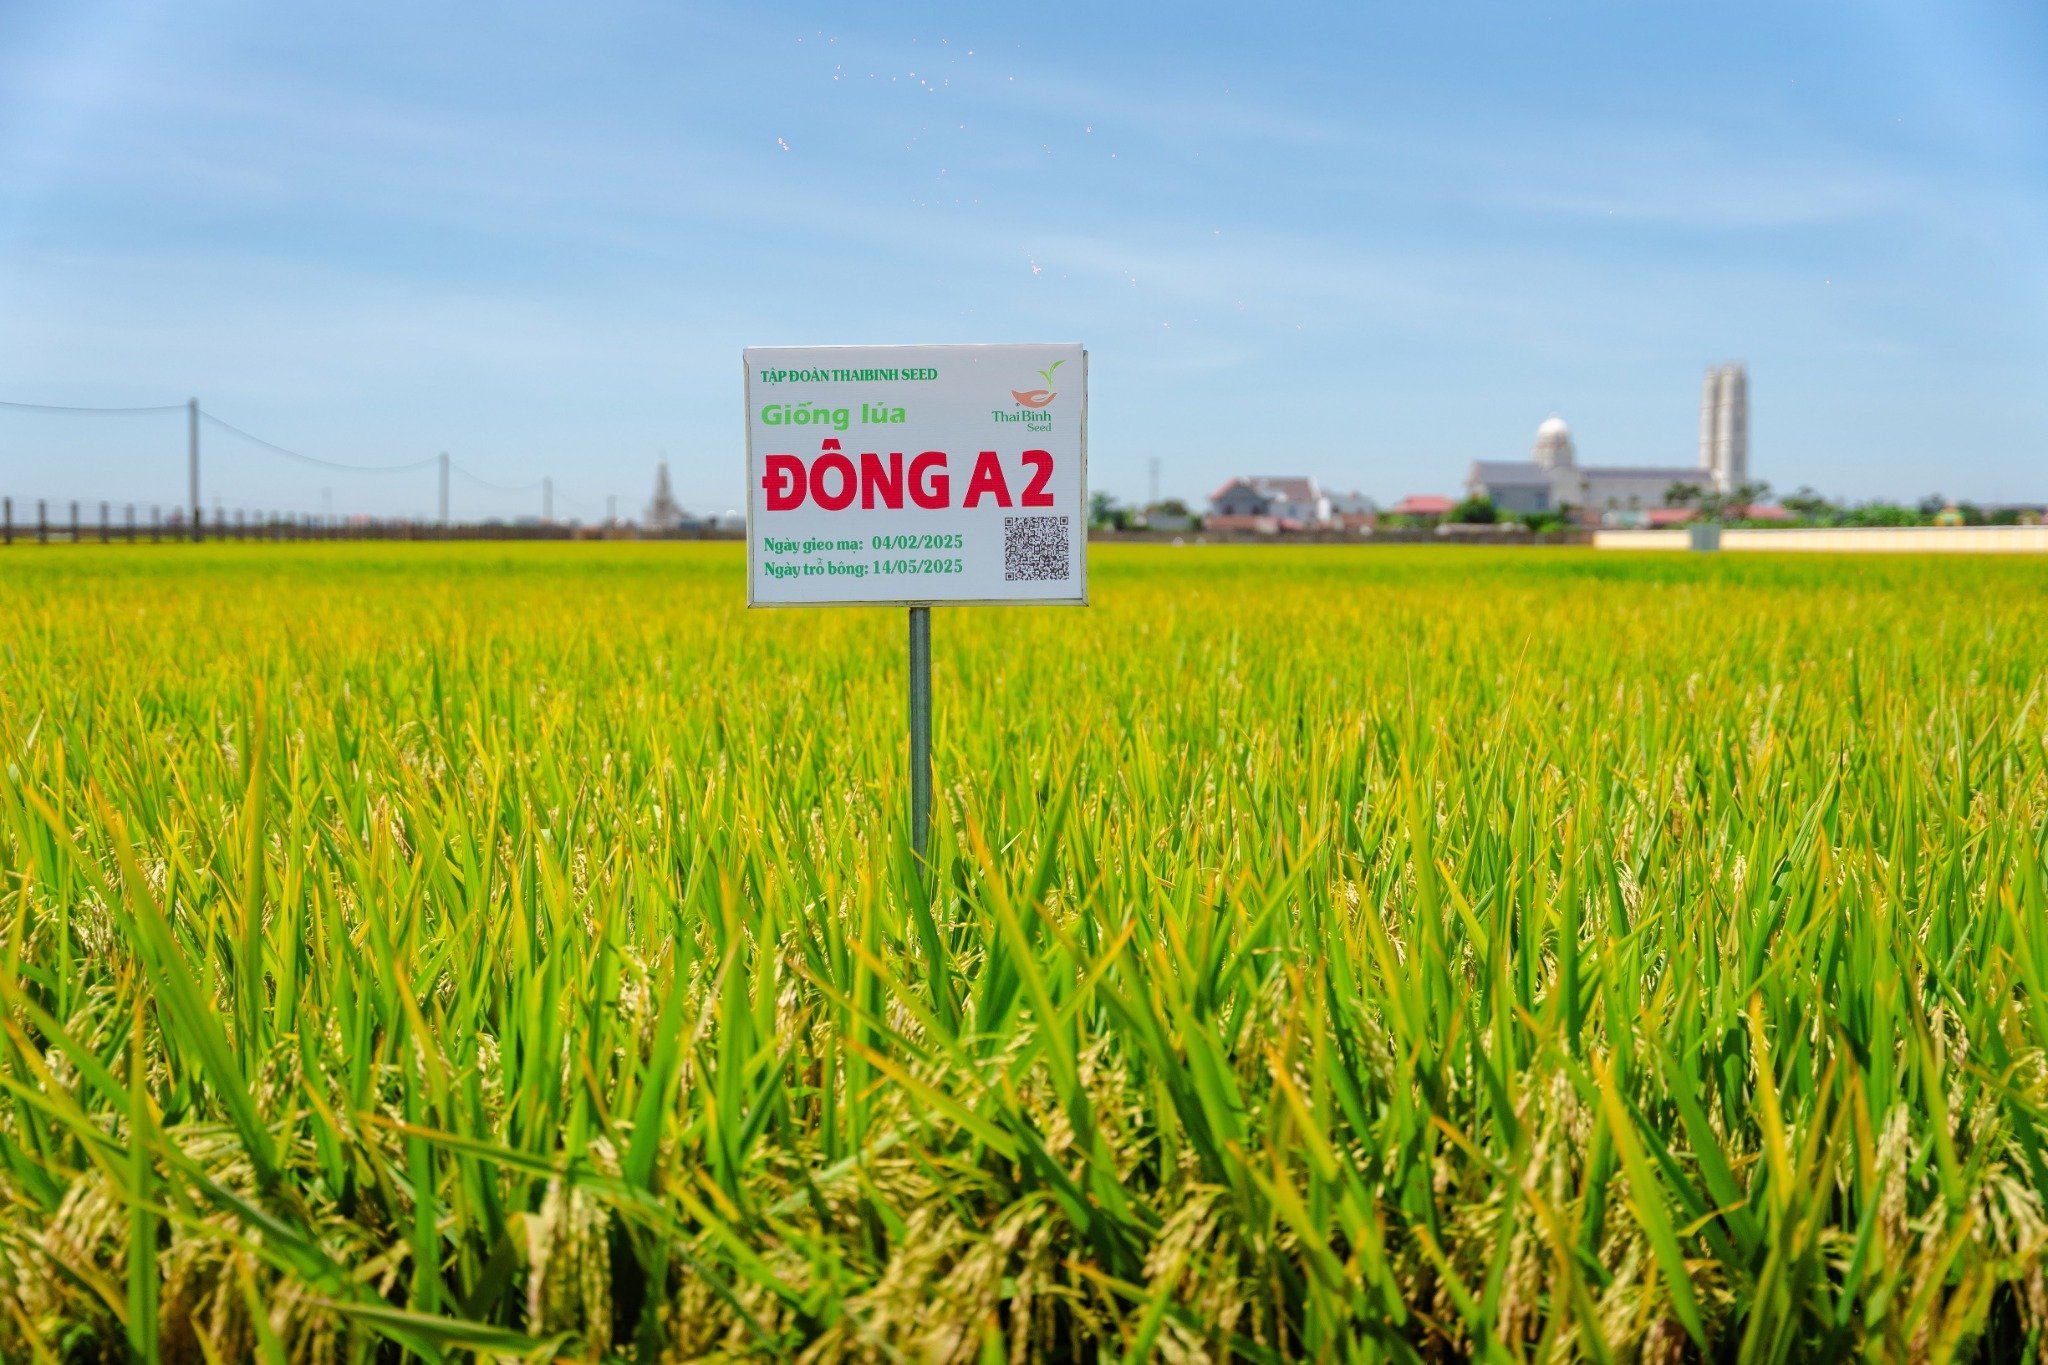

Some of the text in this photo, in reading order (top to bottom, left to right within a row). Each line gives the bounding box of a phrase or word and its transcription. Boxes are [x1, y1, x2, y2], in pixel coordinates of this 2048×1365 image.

[760, 367, 938, 386] TẬP ĐOÀN THAIBINH SEED
[761, 401, 907, 431] Giống lúa
[1027, 422, 1052, 432] Seed
[762, 438, 950, 512] ĐÔNG
[764, 534, 963, 554] Ngày gieo mạ: 04/02/2025
[764, 561, 800, 579] Ngày
[828, 560, 869, 578] bông:
[873, 558, 963, 575] 14/05/2025
